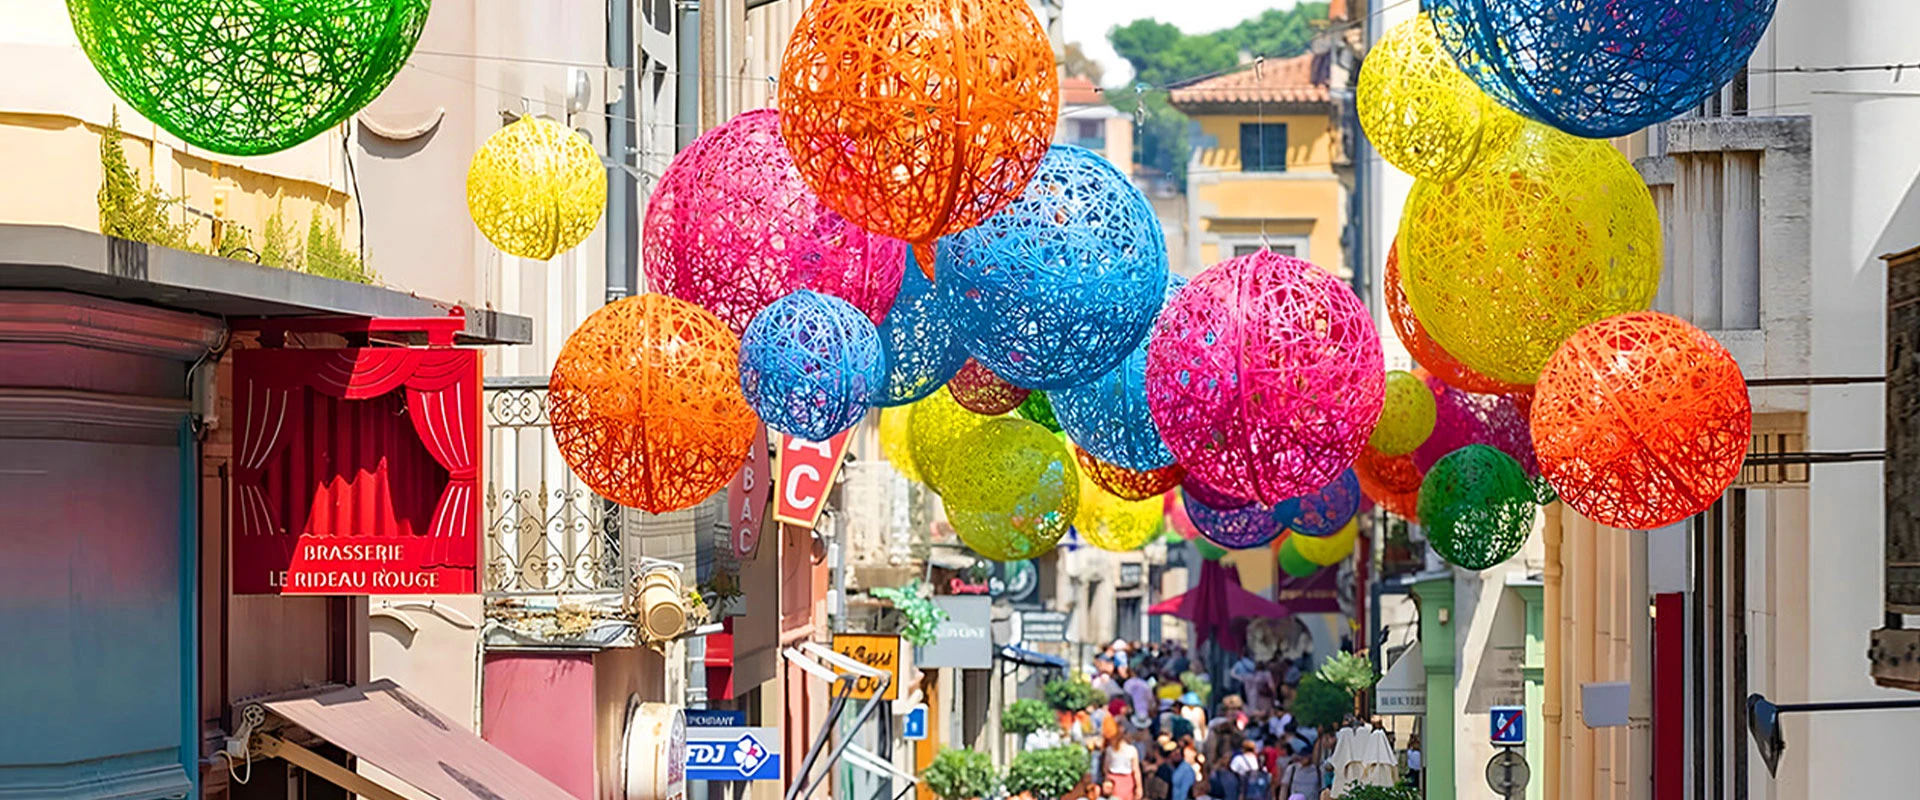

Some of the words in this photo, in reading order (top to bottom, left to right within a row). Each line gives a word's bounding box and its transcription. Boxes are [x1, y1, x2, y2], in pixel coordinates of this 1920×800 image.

[303, 544, 404, 562] BRASSERIE
[269, 570, 288, 587] LE
[295, 571, 366, 588] RIDEAU
[372, 570, 439, 588] ROUGE
[686, 744, 726, 763] FDJ
